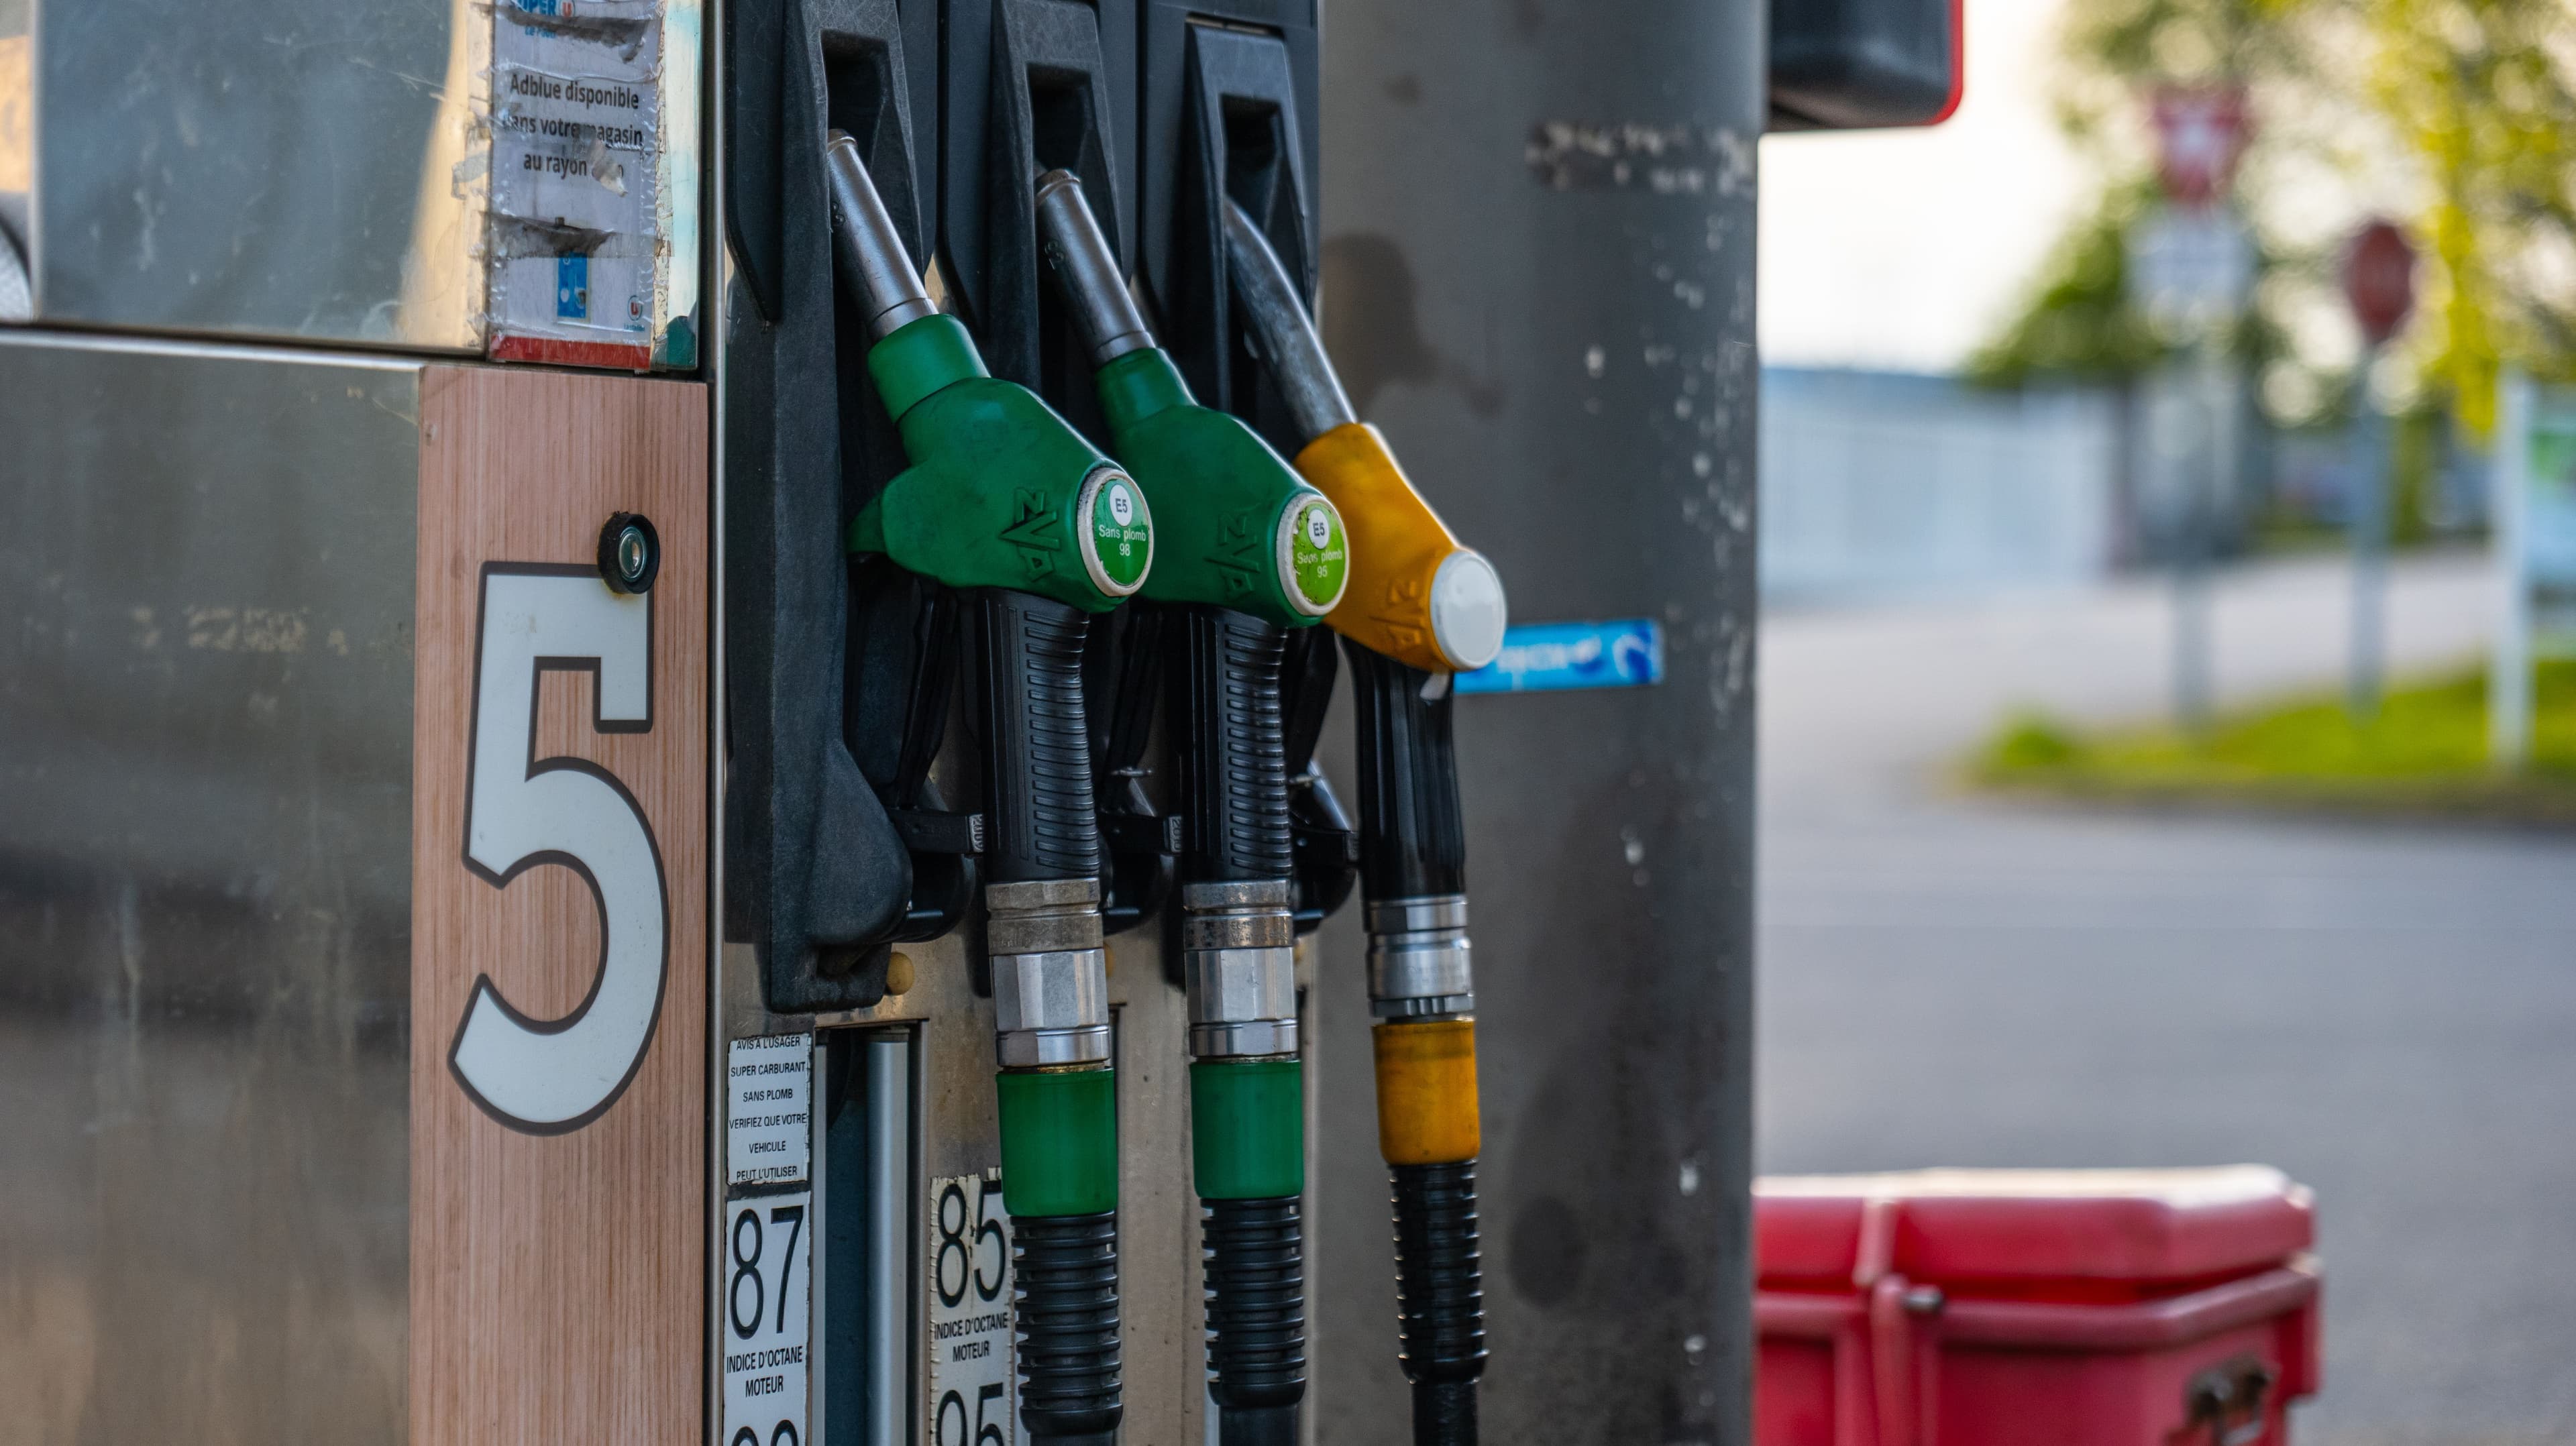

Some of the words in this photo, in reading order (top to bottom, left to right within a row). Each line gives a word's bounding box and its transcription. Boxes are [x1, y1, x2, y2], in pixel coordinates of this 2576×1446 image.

[510, 74, 561, 99] Adblue
[566, 80, 639, 109] disponible
[506, 115, 536, 133] ans
[541, 118, 579, 137] votre
[524, 153, 541, 170] au
[546, 156, 587, 179] rayon
[1115, 498, 1128, 512] E5
[1099, 524, 1120, 538] Sans
[1123, 527, 1146, 542] plomb
[1313, 522, 1325, 537] E5
[1119, 543, 1130, 557] 98
[1321, 550, 1342, 564] plomb
[1317, 565, 1328, 578] 95
[449, 561, 669, 1136] 5
[737, 1040, 754, 1051] AVIS
[755, 1040, 761, 1049] A
[763, 1036, 800, 1049] L'USAGER
[731, 1065, 756, 1077] SUPER
[758, 1062, 806, 1075] CARBURANT
[743, 1091, 764, 1103] SANS
[767, 1089, 793, 1101] PLOMB
[729, 1117, 762, 1129] VERIFIEZ
[764, 1115, 780, 1127] QUE
[782, 1113, 807, 1125] VOTRE
[749, 1141, 786, 1154] VEHICULE
[737, 1170, 756, 1181] PEUT
[759, 1166, 798, 1179] L'UTILISER
[936, 1179, 1006, 1308] 85
[730, 1205, 804, 1339] 87
[934, 1319, 963, 1340] INDICE
[965, 1313, 1008, 1335] D'OCTANE
[727, 1352, 756, 1374] INDICE
[759, 1345, 803, 1369] D'OCTANE
[953, 1340, 989, 1362] MOTEUR
[745, 1375, 784, 1398] MOTEUR
